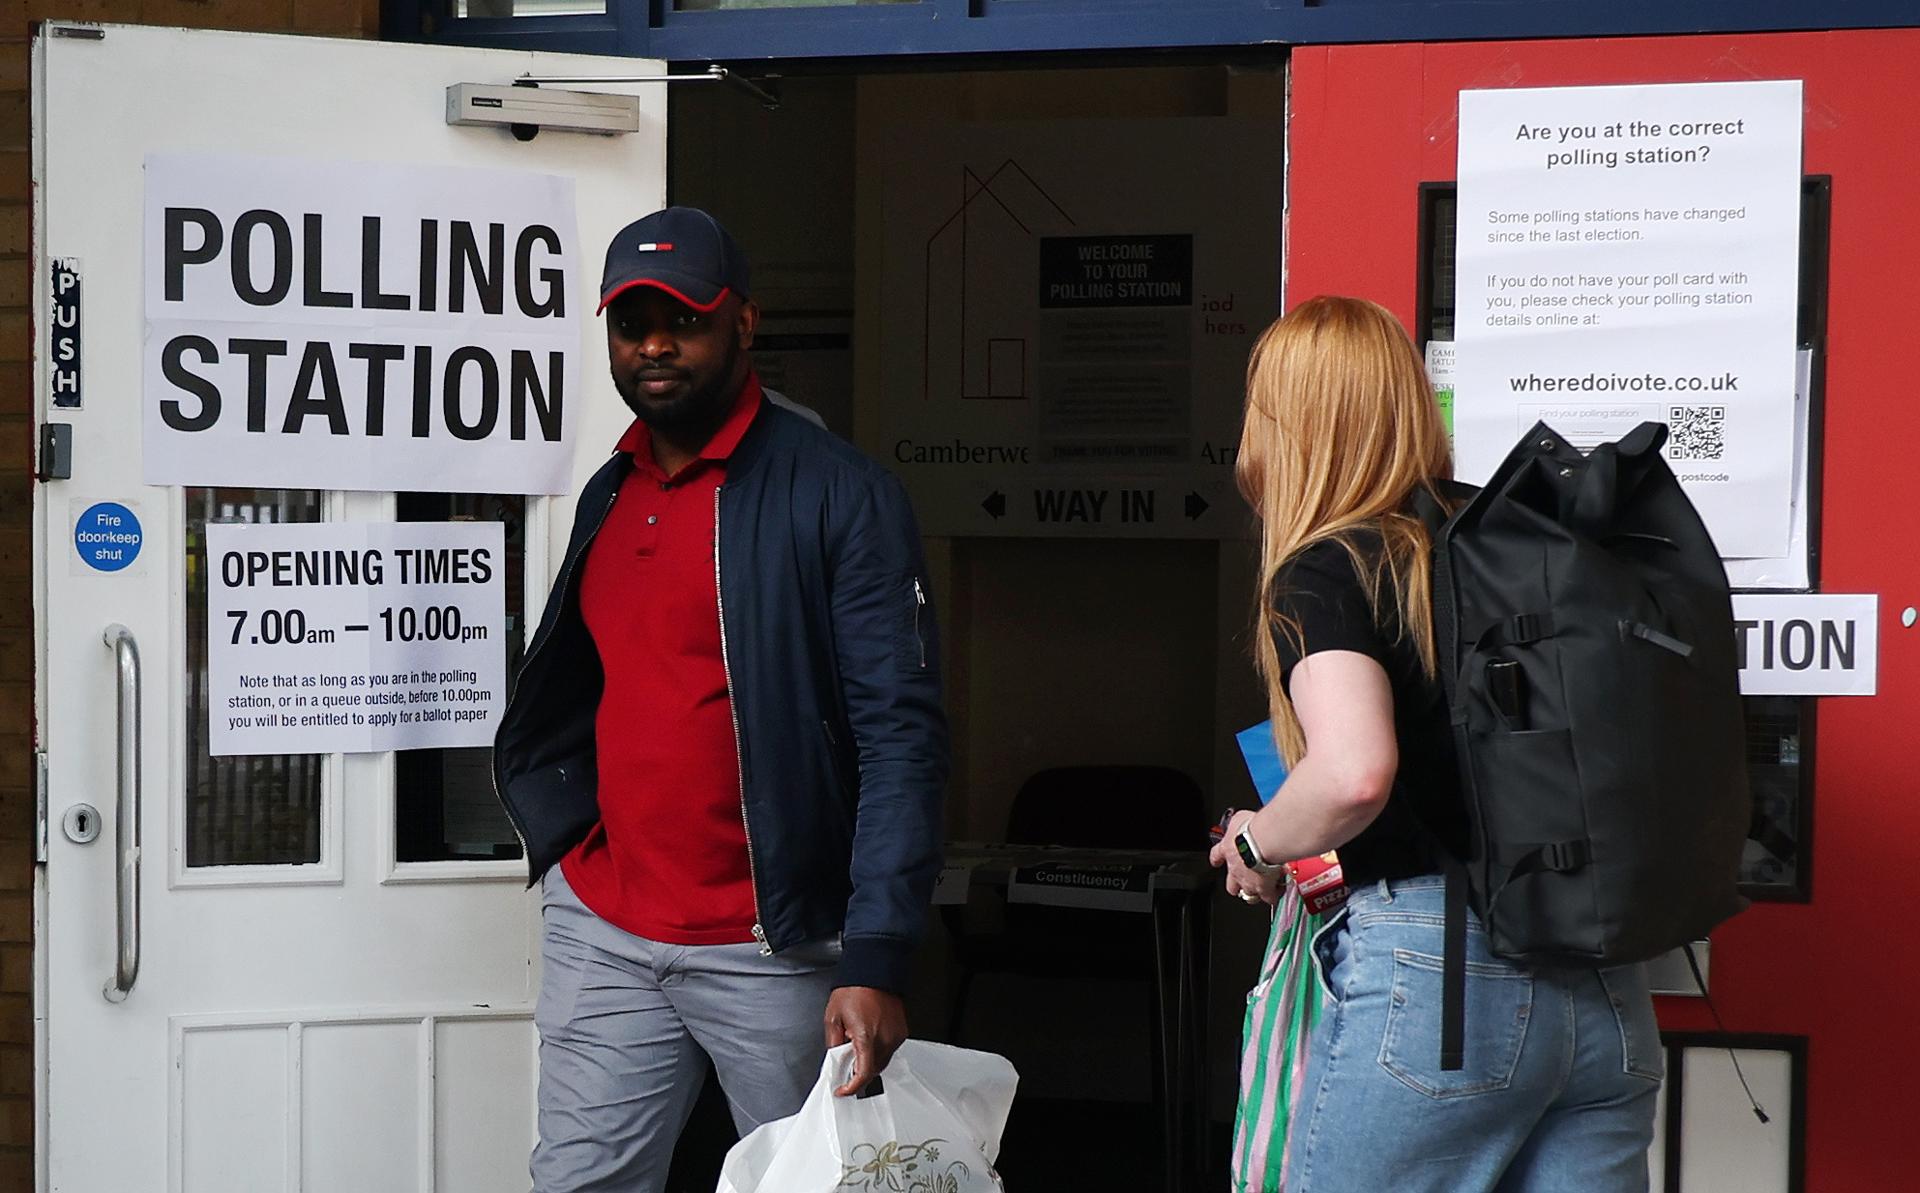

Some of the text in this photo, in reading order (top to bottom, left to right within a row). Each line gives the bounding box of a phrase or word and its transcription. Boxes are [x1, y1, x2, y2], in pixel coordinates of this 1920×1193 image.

[1516, 119, 1745, 144] Are you at the correct
[1547, 145, 1711, 169] polling station?
[1488, 206, 1746, 226] Some polling stations have changed
[1487, 228, 1645, 243] since the last election.
[1078, 244, 1154, 261] WELCOME
[164, 208, 565, 318] POLLING
[1083, 263, 1148, 280] TO YOUR
[1050, 281, 1181, 300] POLLING STATION
[1487, 272, 1748, 291] If you do not have your poll card with
[1486, 292, 1753, 310] you, please check your polling station
[1486, 313, 1601, 327] details online at:
[56, 272, 77, 394] PUSH
[160, 335, 563, 442] STATION
[1510, 372, 1739, 392] wheredoivote.co.uk
[1681, 473, 1730, 482] postcode
[1034, 489, 1154, 523] WAY IN
[97, 514, 121, 526] Fire
[95, 548, 122, 560] shut
[222, 549, 492, 587] OPENING TIMES
[226, 609, 335, 645] 7.00am
[379, 605, 488, 643] 10.00pm
[240, 670, 477, 689] Note that as long as you are in the polling
[228, 689, 491, 709] station, or in a queue outside, before 10.00pm
[228, 708, 488, 731] you will be entitled to apply for a ballot paper
[1035, 870, 1129, 890] Constituency
